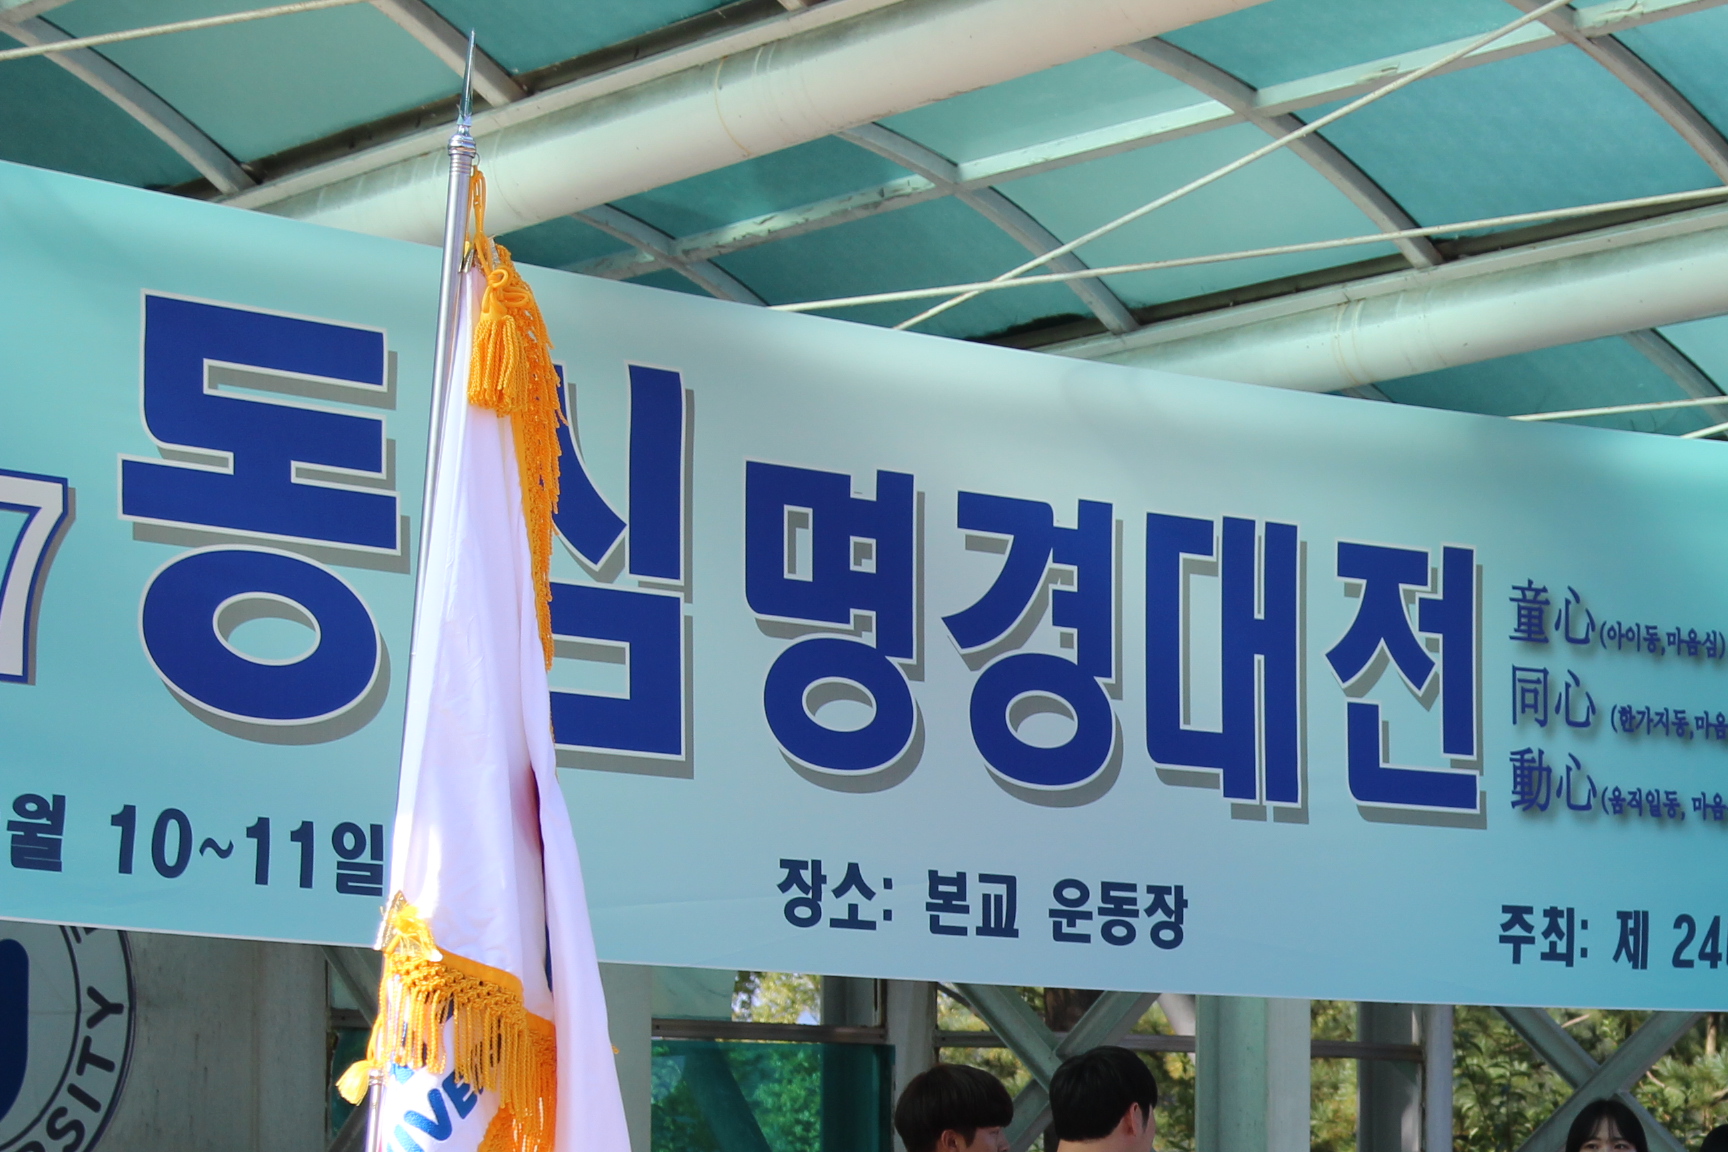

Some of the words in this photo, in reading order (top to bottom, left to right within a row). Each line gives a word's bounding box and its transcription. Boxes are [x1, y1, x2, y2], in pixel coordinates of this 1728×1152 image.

[1510, 663, 1597, 729] 同心
[6, 792, 67, 873] 월
[110, 803, 385, 897] 10~11일
[777, 857, 894, 931] 장소:
[925, 868, 1020, 939] 본교
[1048, 877, 1189, 950] 운동장
[1498, 904, 1589, 968] 주최:
[1612, 909, 1650, 970] 제
